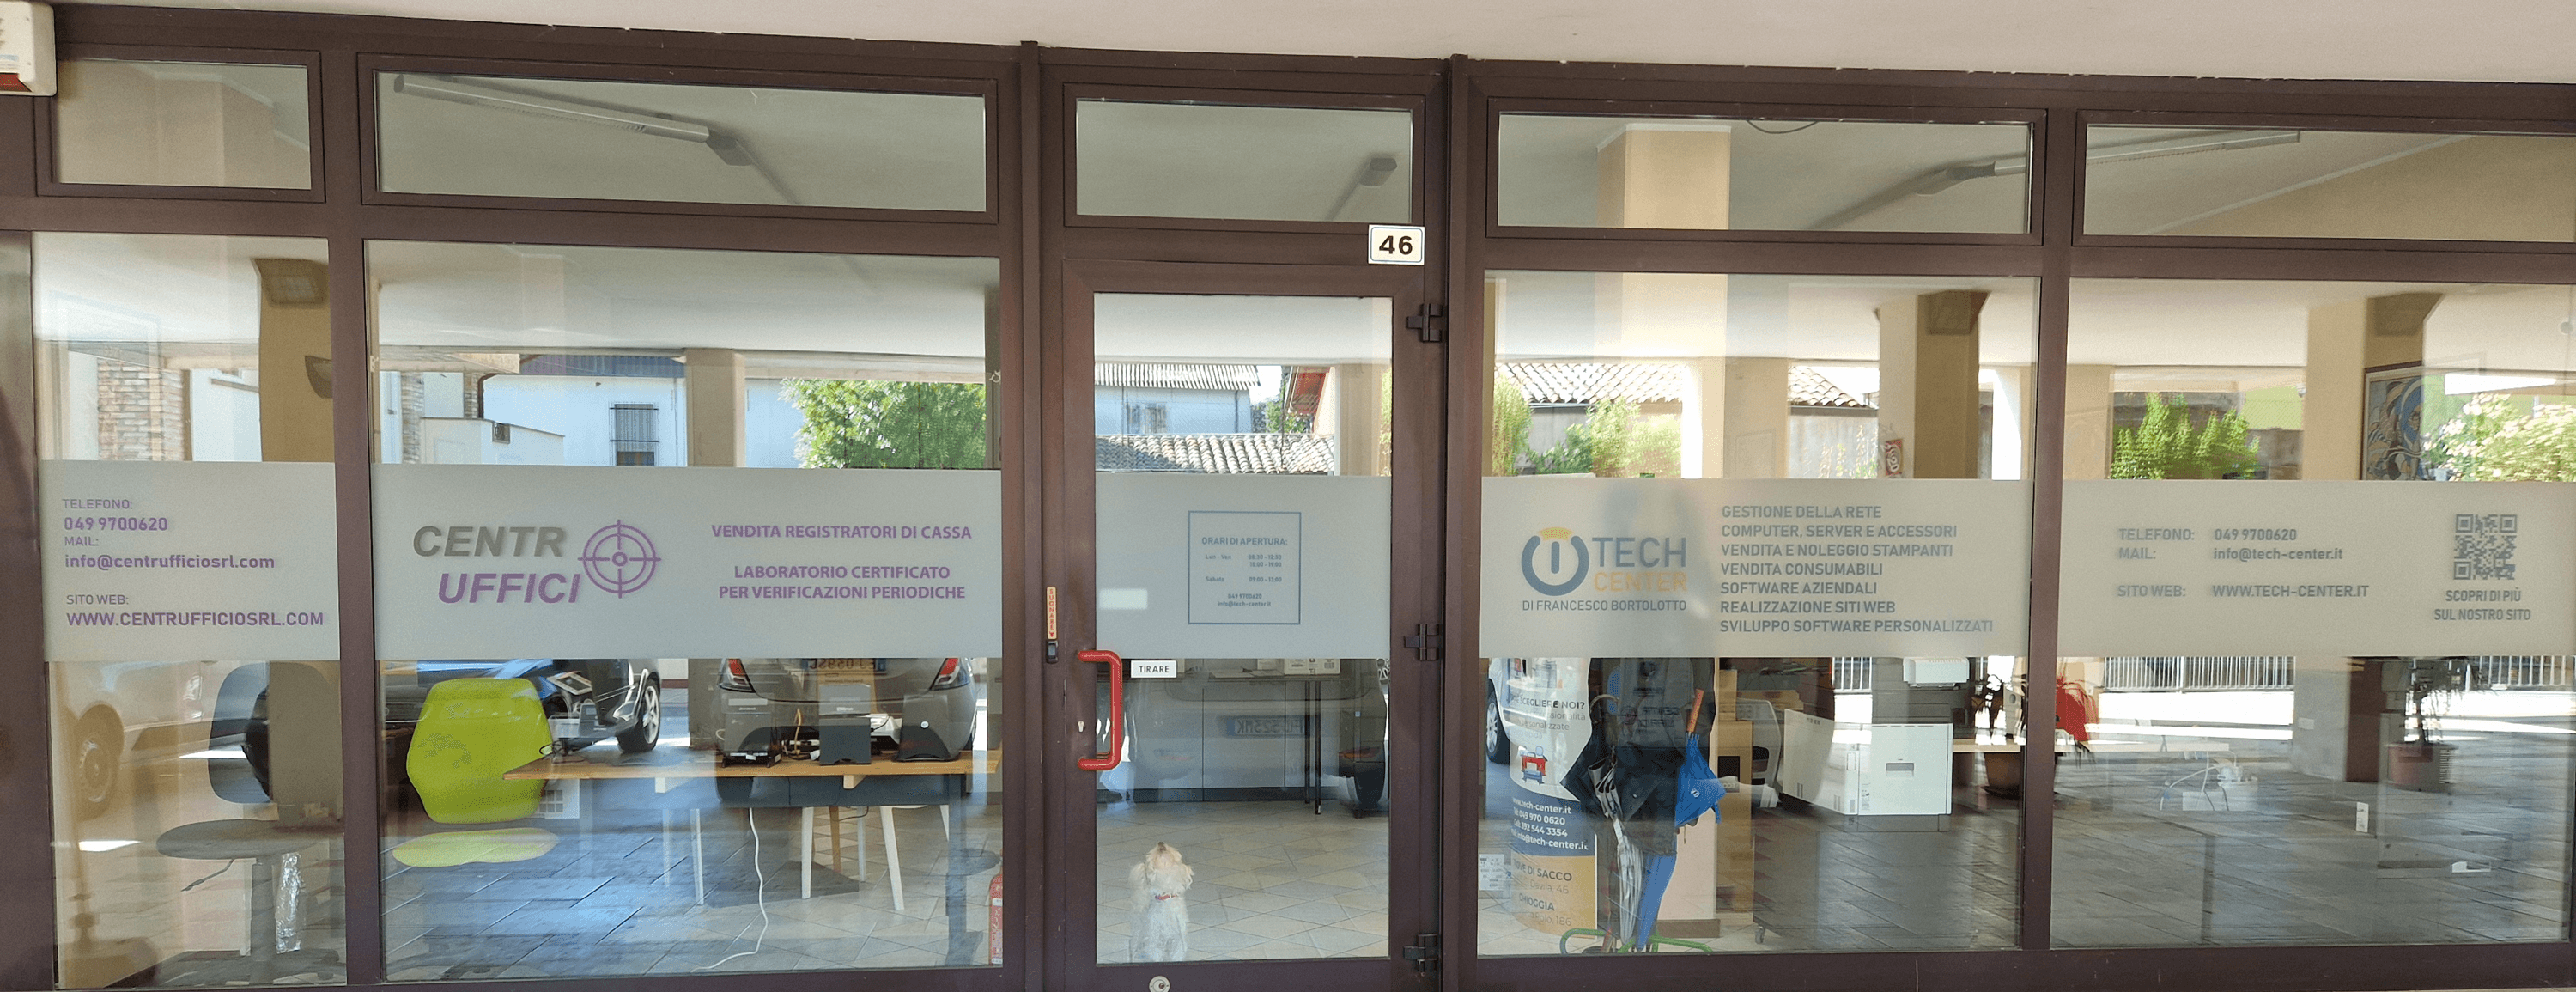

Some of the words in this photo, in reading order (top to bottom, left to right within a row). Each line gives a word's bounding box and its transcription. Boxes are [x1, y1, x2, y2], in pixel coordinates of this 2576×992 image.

[1379, 235, 1413, 255] 46
[63, 498, 132, 509] TELEFONO:
[1721, 506, 1793, 519] GESTIONE
[1796, 506, 1843, 519] DELLA
[1846, 507, 1882, 519] RETE
[64, 517, 94, 531] 049
[99, 517, 168, 531] 9700620
[711, 524, 781, 539] VENDITA
[785, 525, 897, 539] REGISTRATORI
[901, 526, 916, 539] DI
[920, 526, 972, 539] CASSA
[1721, 526, 1803, 539] COMPUTER,
[1805, 526, 1862, 538] SERVER
[1866, 526, 1874, 538] E
[1877, 526, 1958, 538] ACCESSORI
[2118, 528, 2195, 541] TELEFONO:
[2215, 528, 2239, 541] 049
[2241, 528, 2297, 541] 9700620
[64, 536, 99, 546] MAIL:
[412, 526, 565, 558] CENTR
[1592, 537, 1686, 568] TECH
[1721, 545, 1782, 557] VENDITA
[1786, 545, 1795, 557] E
[1797, 545, 1870, 557] NOLEGGIO
[1872, 545, 1953, 557] STAMPANTI
[2117, 547, 2157, 560] MAIL:
[2213, 547, 2343, 563] info@tech-center.it
[65, 554, 275, 570] info@centrufficiosrl.com
[734, 565, 848, 579] LABORATORIO
[851, 565, 951, 579] CERTIFICATO
[1721, 563, 1782, 575] VENDITA
[1785, 563, 1883, 575] CONSUMABILI
[437, 573, 580, 603] UFFICI
[1593, 571, 1687, 592] CENTER
[1721, 582, 1799, 594] SOFTWARE
[1802, 582, 1877, 594] AZIENDALI
[719, 585, 748, 599] PER
[750, 585, 868, 599] VERIFICAZIONI
[872, 585, 965, 599] PERIODICHE
[2117, 585, 2148, 597] SITO
[2151, 585, 2186, 597] WEB:
[2212, 585, 2369, 598] WWW.TECH-CENTER.IT
[2445, 589, 2488, 601] SCOPRI
[2489, 590, 2500, 601] DI
[2502, 587, 2522, 601] PIÙ
[66, 594, 94, 605] SITO
[97, 594, 129, 605] WEB:
[1522, 600, 1534, 611] DI
[1537, 599, 1607, 612] FRANCESCO
[1611, 599, 1686, 611] BORTOLOTTO
[1721, 601, 1832, 613] REALIZZAZIONE
[1835, 601, 1862, 613] SITI
[1864, 601, 1896, 613] WEB
[67, 612, 324, 626] WWW.CENTRUFFICIOSRL.COM
[2433, 609, 2456, 620] SUL
[2458, 609, 2504, 620] NOSTRO
[2506, 609, 2531, 620] SITO
[1720, 620, 1790, 632] SVILUPPO
[1793, 620, 1872, 632] SOFTWARE
[1874, 620, 1994, 632] PERSONALIZZATI
[1139, 665, 1170, 674] TIRARE
[1520, 697, 1558, 708] SCEGLIERE
[1513, 798, 1571, 814] www.tech-center.it
[1519, 810, 1528, 819] 049
[1529, 813, 1541, 822] 970
[1544, 816, 1565, 825] 0620
[1531, 825, 1545, 834] 544
[1546, 827, 1568, 837] 3354
[1528, 866, 1534, 875] DI
[1537, 868, 1572, 881] SACCO
[1557, 885, 1569, 894] 46
[1519, 893, 1555, 910] CHIOGGIA
[1557, 916, 1571, 926] 186
